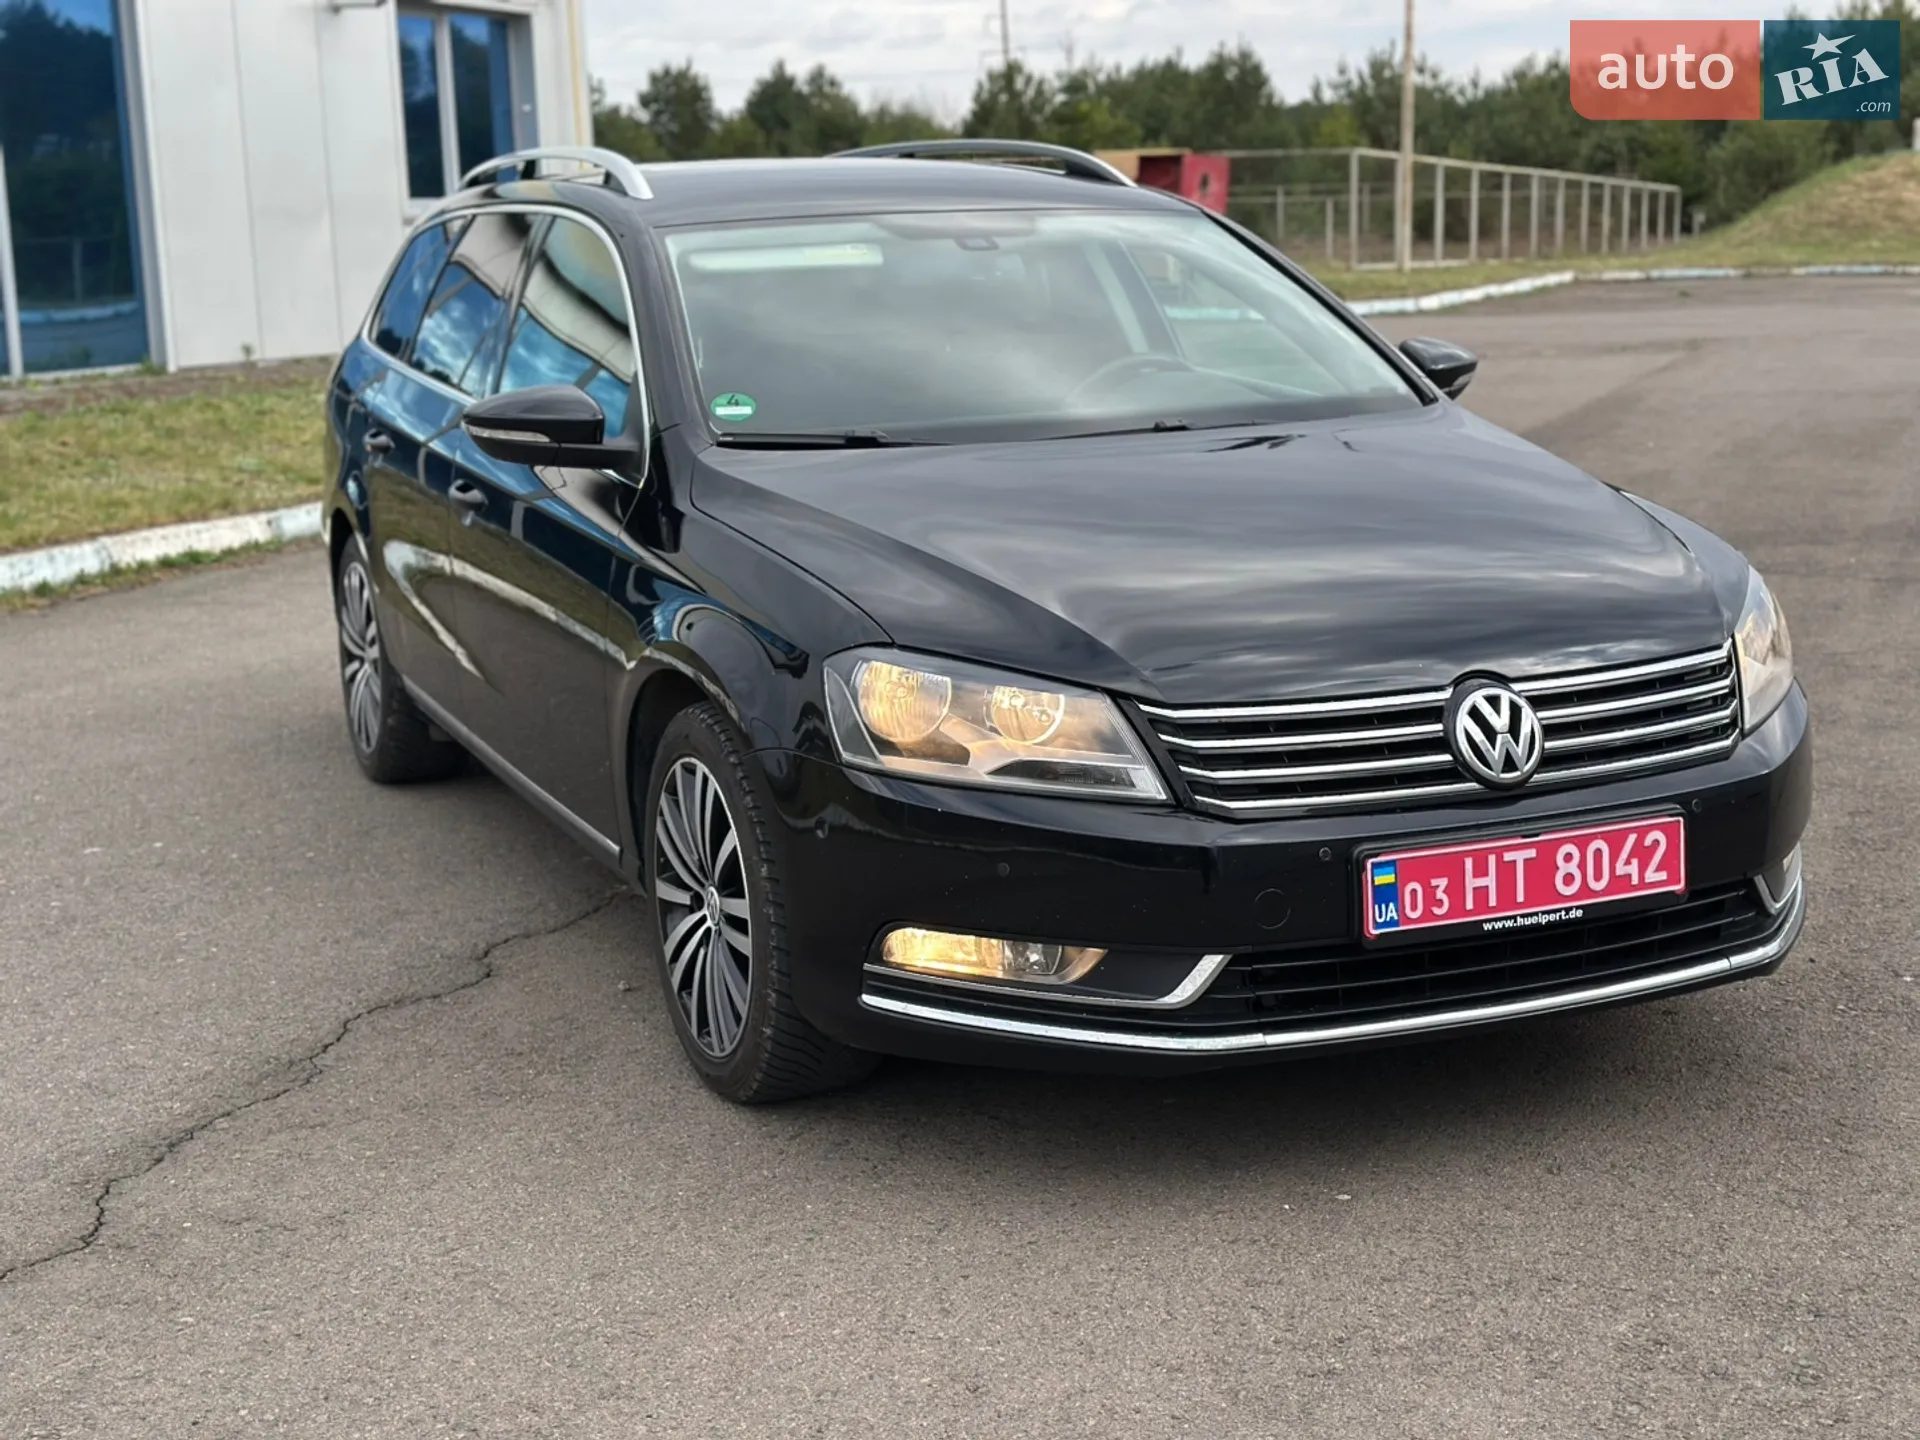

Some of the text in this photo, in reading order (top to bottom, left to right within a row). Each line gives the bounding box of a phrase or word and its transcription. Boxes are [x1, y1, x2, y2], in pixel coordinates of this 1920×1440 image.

[1459, 690, 1539, 780] VW
[1404, 830, 1668, 919] 03 HT 8042
[1374, 904, 1398, 923] UA
[1482, 907, 1583, 931] www.huelpert.de
